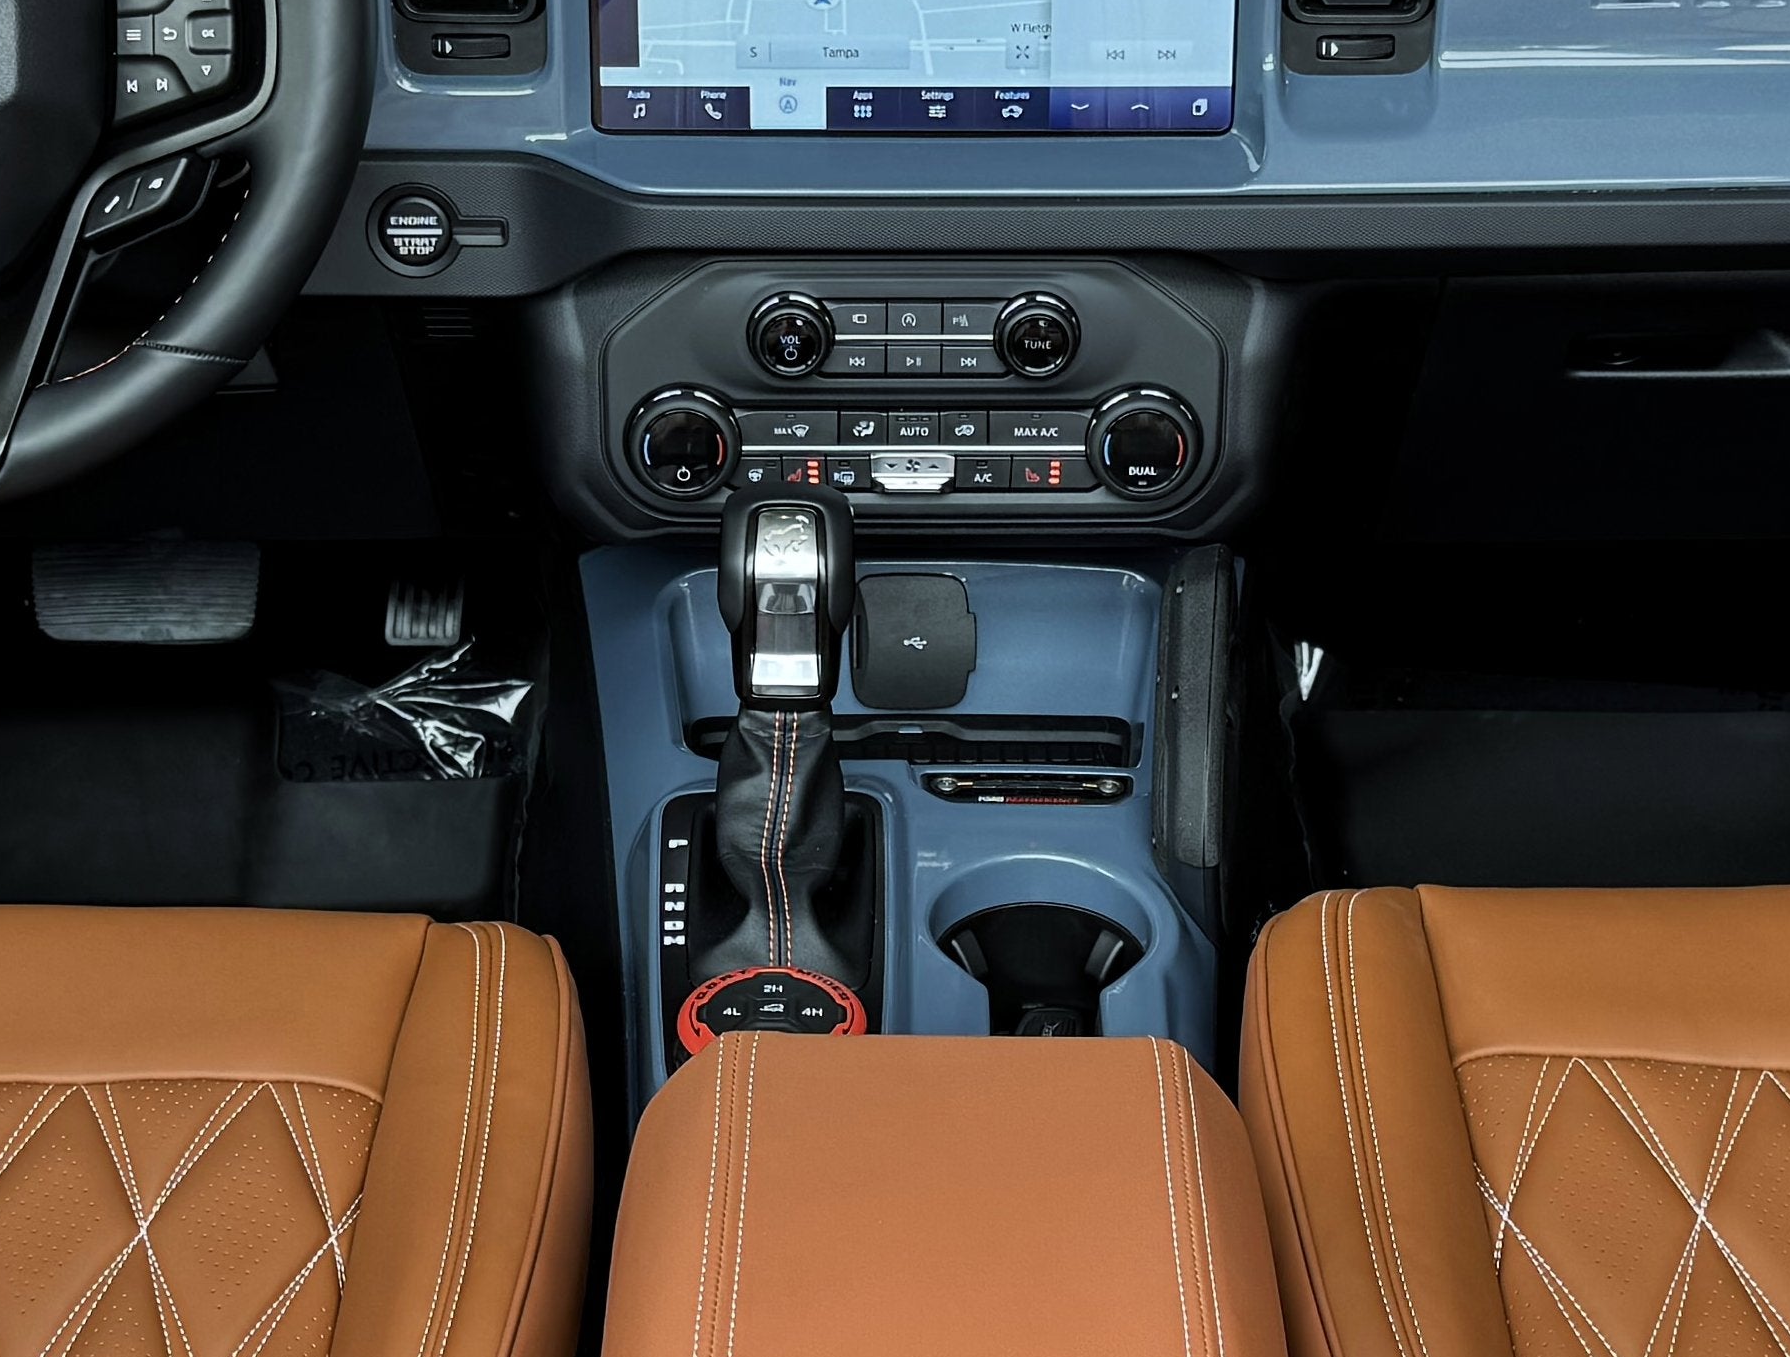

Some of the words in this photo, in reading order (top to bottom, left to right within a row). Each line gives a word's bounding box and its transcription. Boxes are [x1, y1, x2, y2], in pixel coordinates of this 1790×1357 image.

[1010, 24, 1021, 32] W
[750, 47, 758, 58] S
[823, 47, 859, 59] Tampa
[779, 77, 796, 86] Nav
[627, 90, 651, 100] Audio
[701, 90, 726, 100] Phone
[853, 90, 873, 101] Apps
[921, 90, 954, 101] Settings
[389, 216, 439, 226] ENGINE
[399, 246, 435, 255] STOP
[780, 334, 801, 345] VOL
[1024, 339, 1052, 350] TUNE
[899, 426, 929, 436] AUTO
[1014, 427, 1038, 437] MAX
[1040, 426, 1059, 437] A/C
[1128, 466, 1157, 476] DUAL
[974, 473, 993, 483] A/C
[763, 984, 783, 993] 2H
[722, 1007, 741, 1016] 4L
[801, 1007, 823, 1017] 4H
